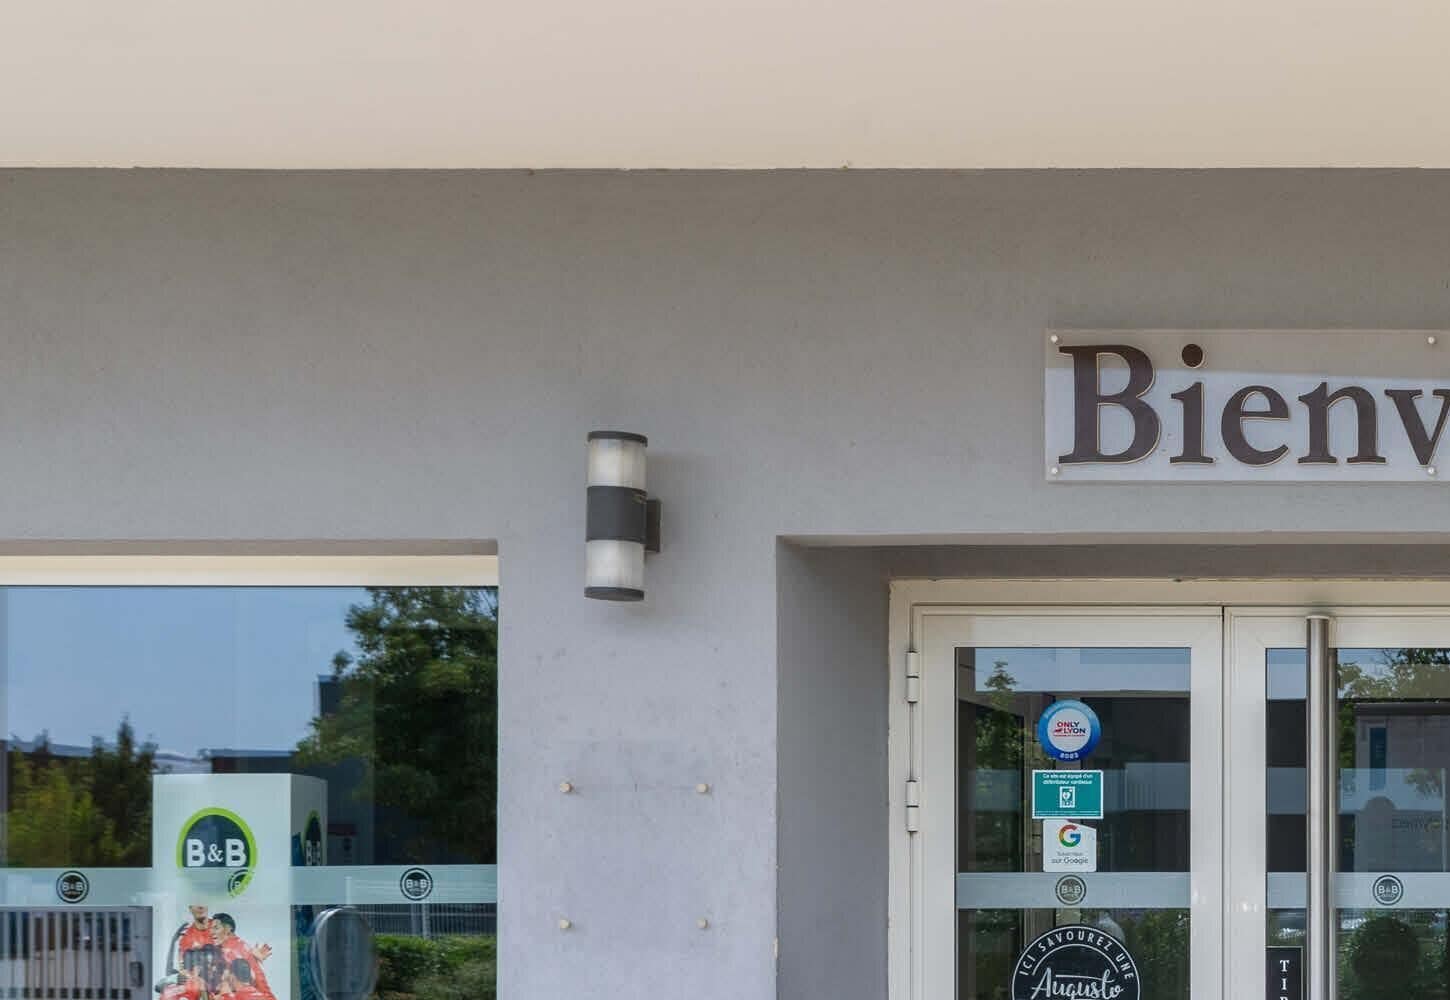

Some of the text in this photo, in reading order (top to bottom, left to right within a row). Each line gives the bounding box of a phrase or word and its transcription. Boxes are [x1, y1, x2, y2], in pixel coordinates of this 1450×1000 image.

[1059, 824, 1081, 848] G
[186, 838, 246, 867] B&B
[1019, 931, 1134, 979] ICI SAVOUREZ UNE
